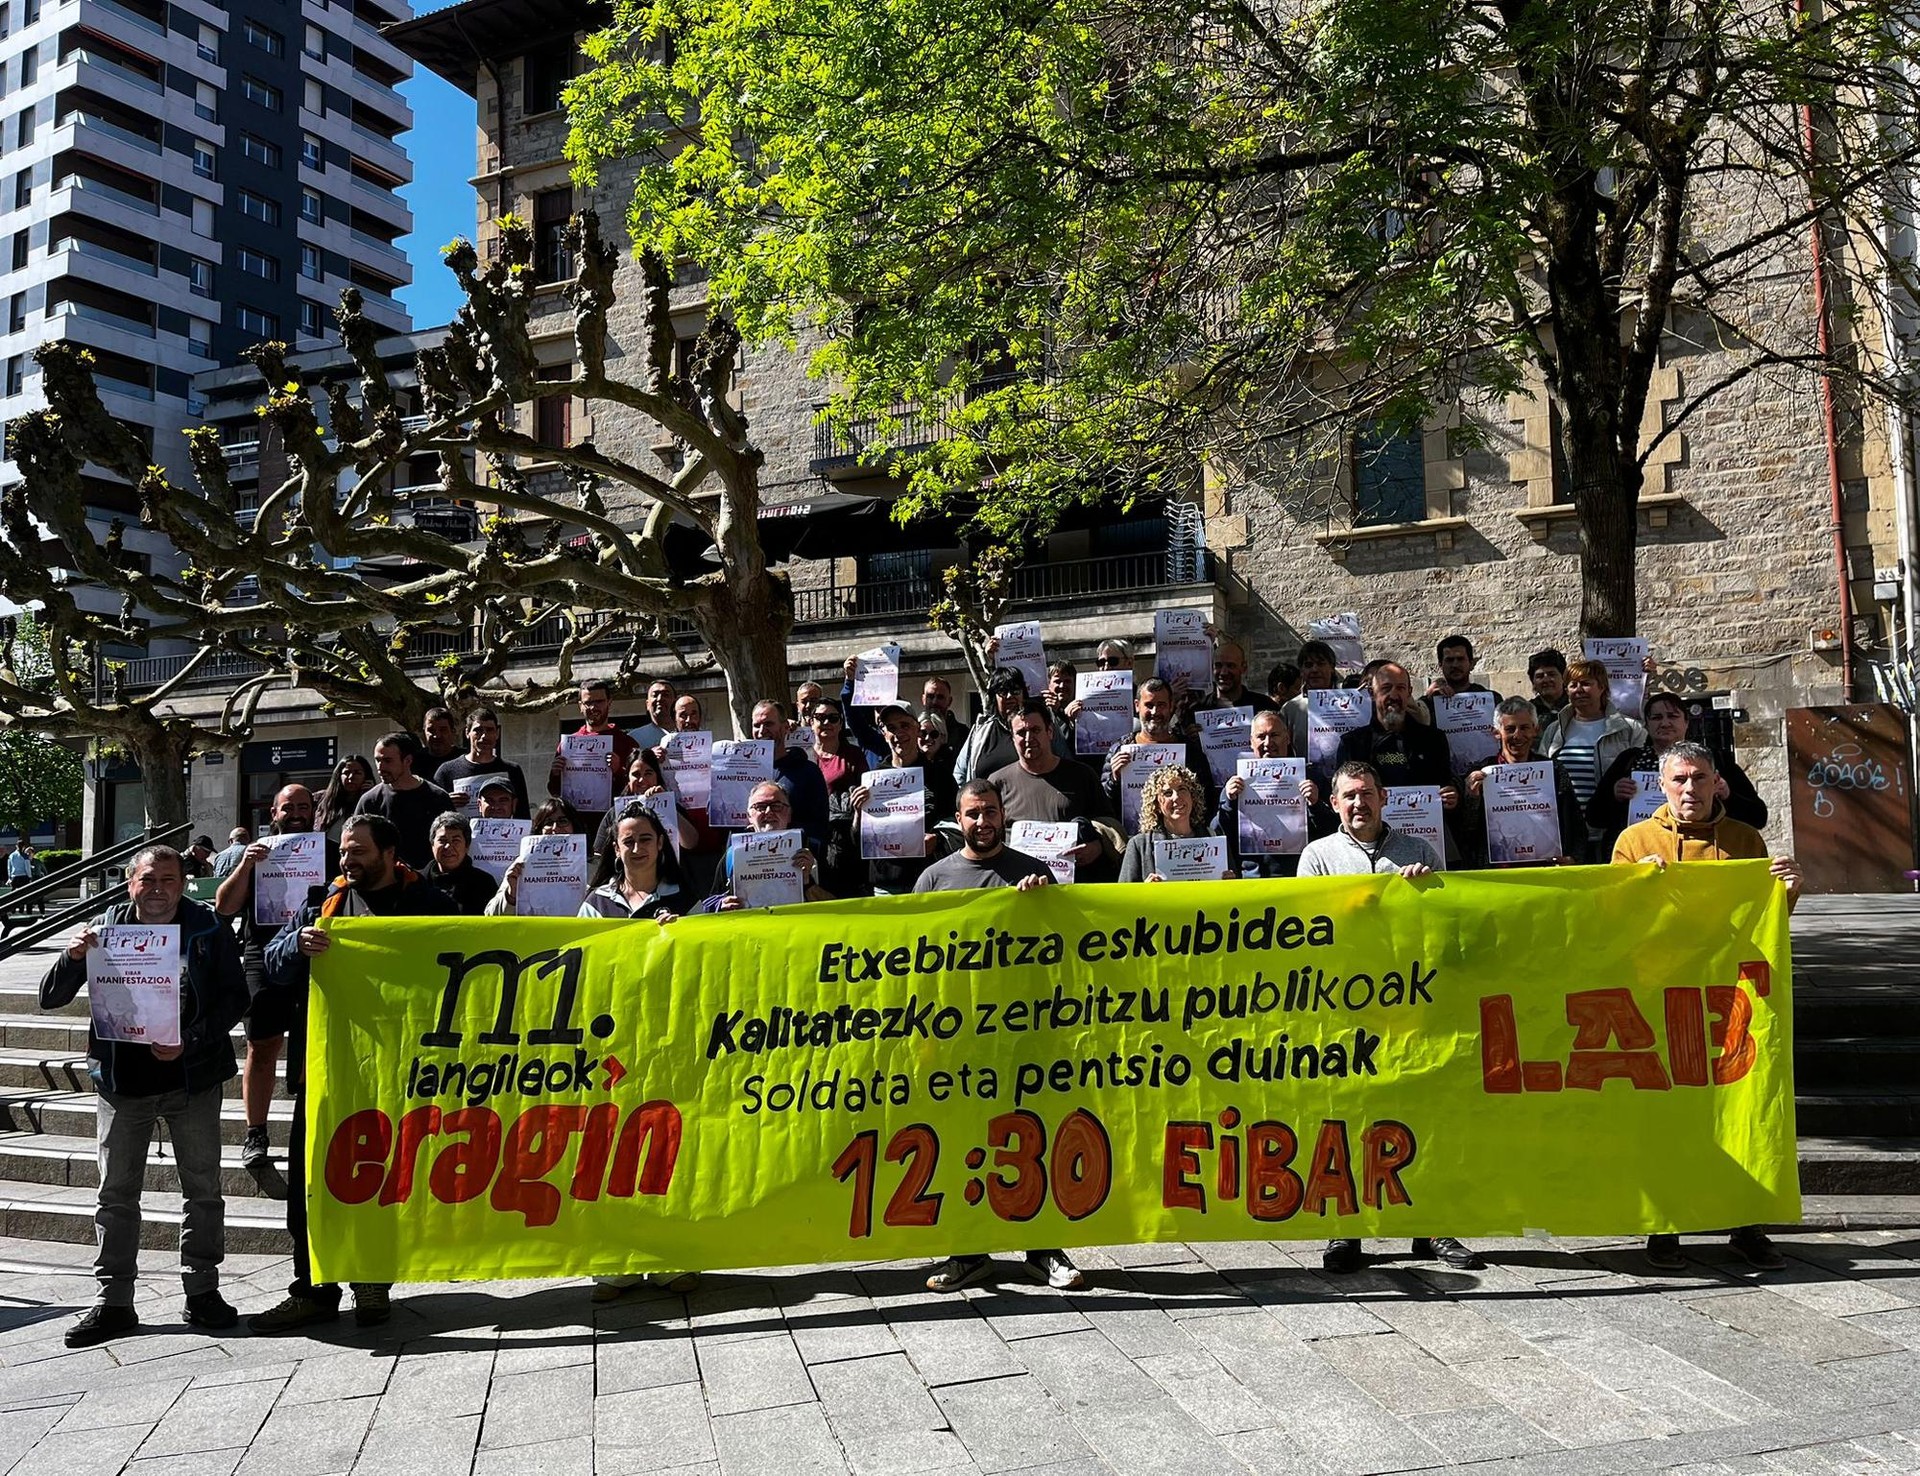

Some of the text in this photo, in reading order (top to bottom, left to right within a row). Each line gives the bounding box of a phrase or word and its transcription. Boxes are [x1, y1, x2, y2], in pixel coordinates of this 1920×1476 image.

[868, 805, 919, 814] MANIFESTAZIOA
[1492, 803, 1551, 813] MANIFESTAZIOA
[1263, 839, 1282, 847] LAB
[1515, 845, 1535, 854] LAB
[262, 870, 320, 879] MANIFESTAZIOA
[740, 871, 797, 881] MANIFESTAZIOA
[817, 906, 1335, 985] Etxebizitza eskubidea
[96, 976, 172, 985] MANIFESTAZIOA
[705, 960, 1438, 1060] Kalitatezko zerbitzu publikoak
[123, 1026, 145, 1036] LAB
[1478, 960, 1771, 1095] LAB
[741, 1027, 1381, 1115] Soldata eta pentsio duinak
[324, 1099, 683, 1228] eragin
